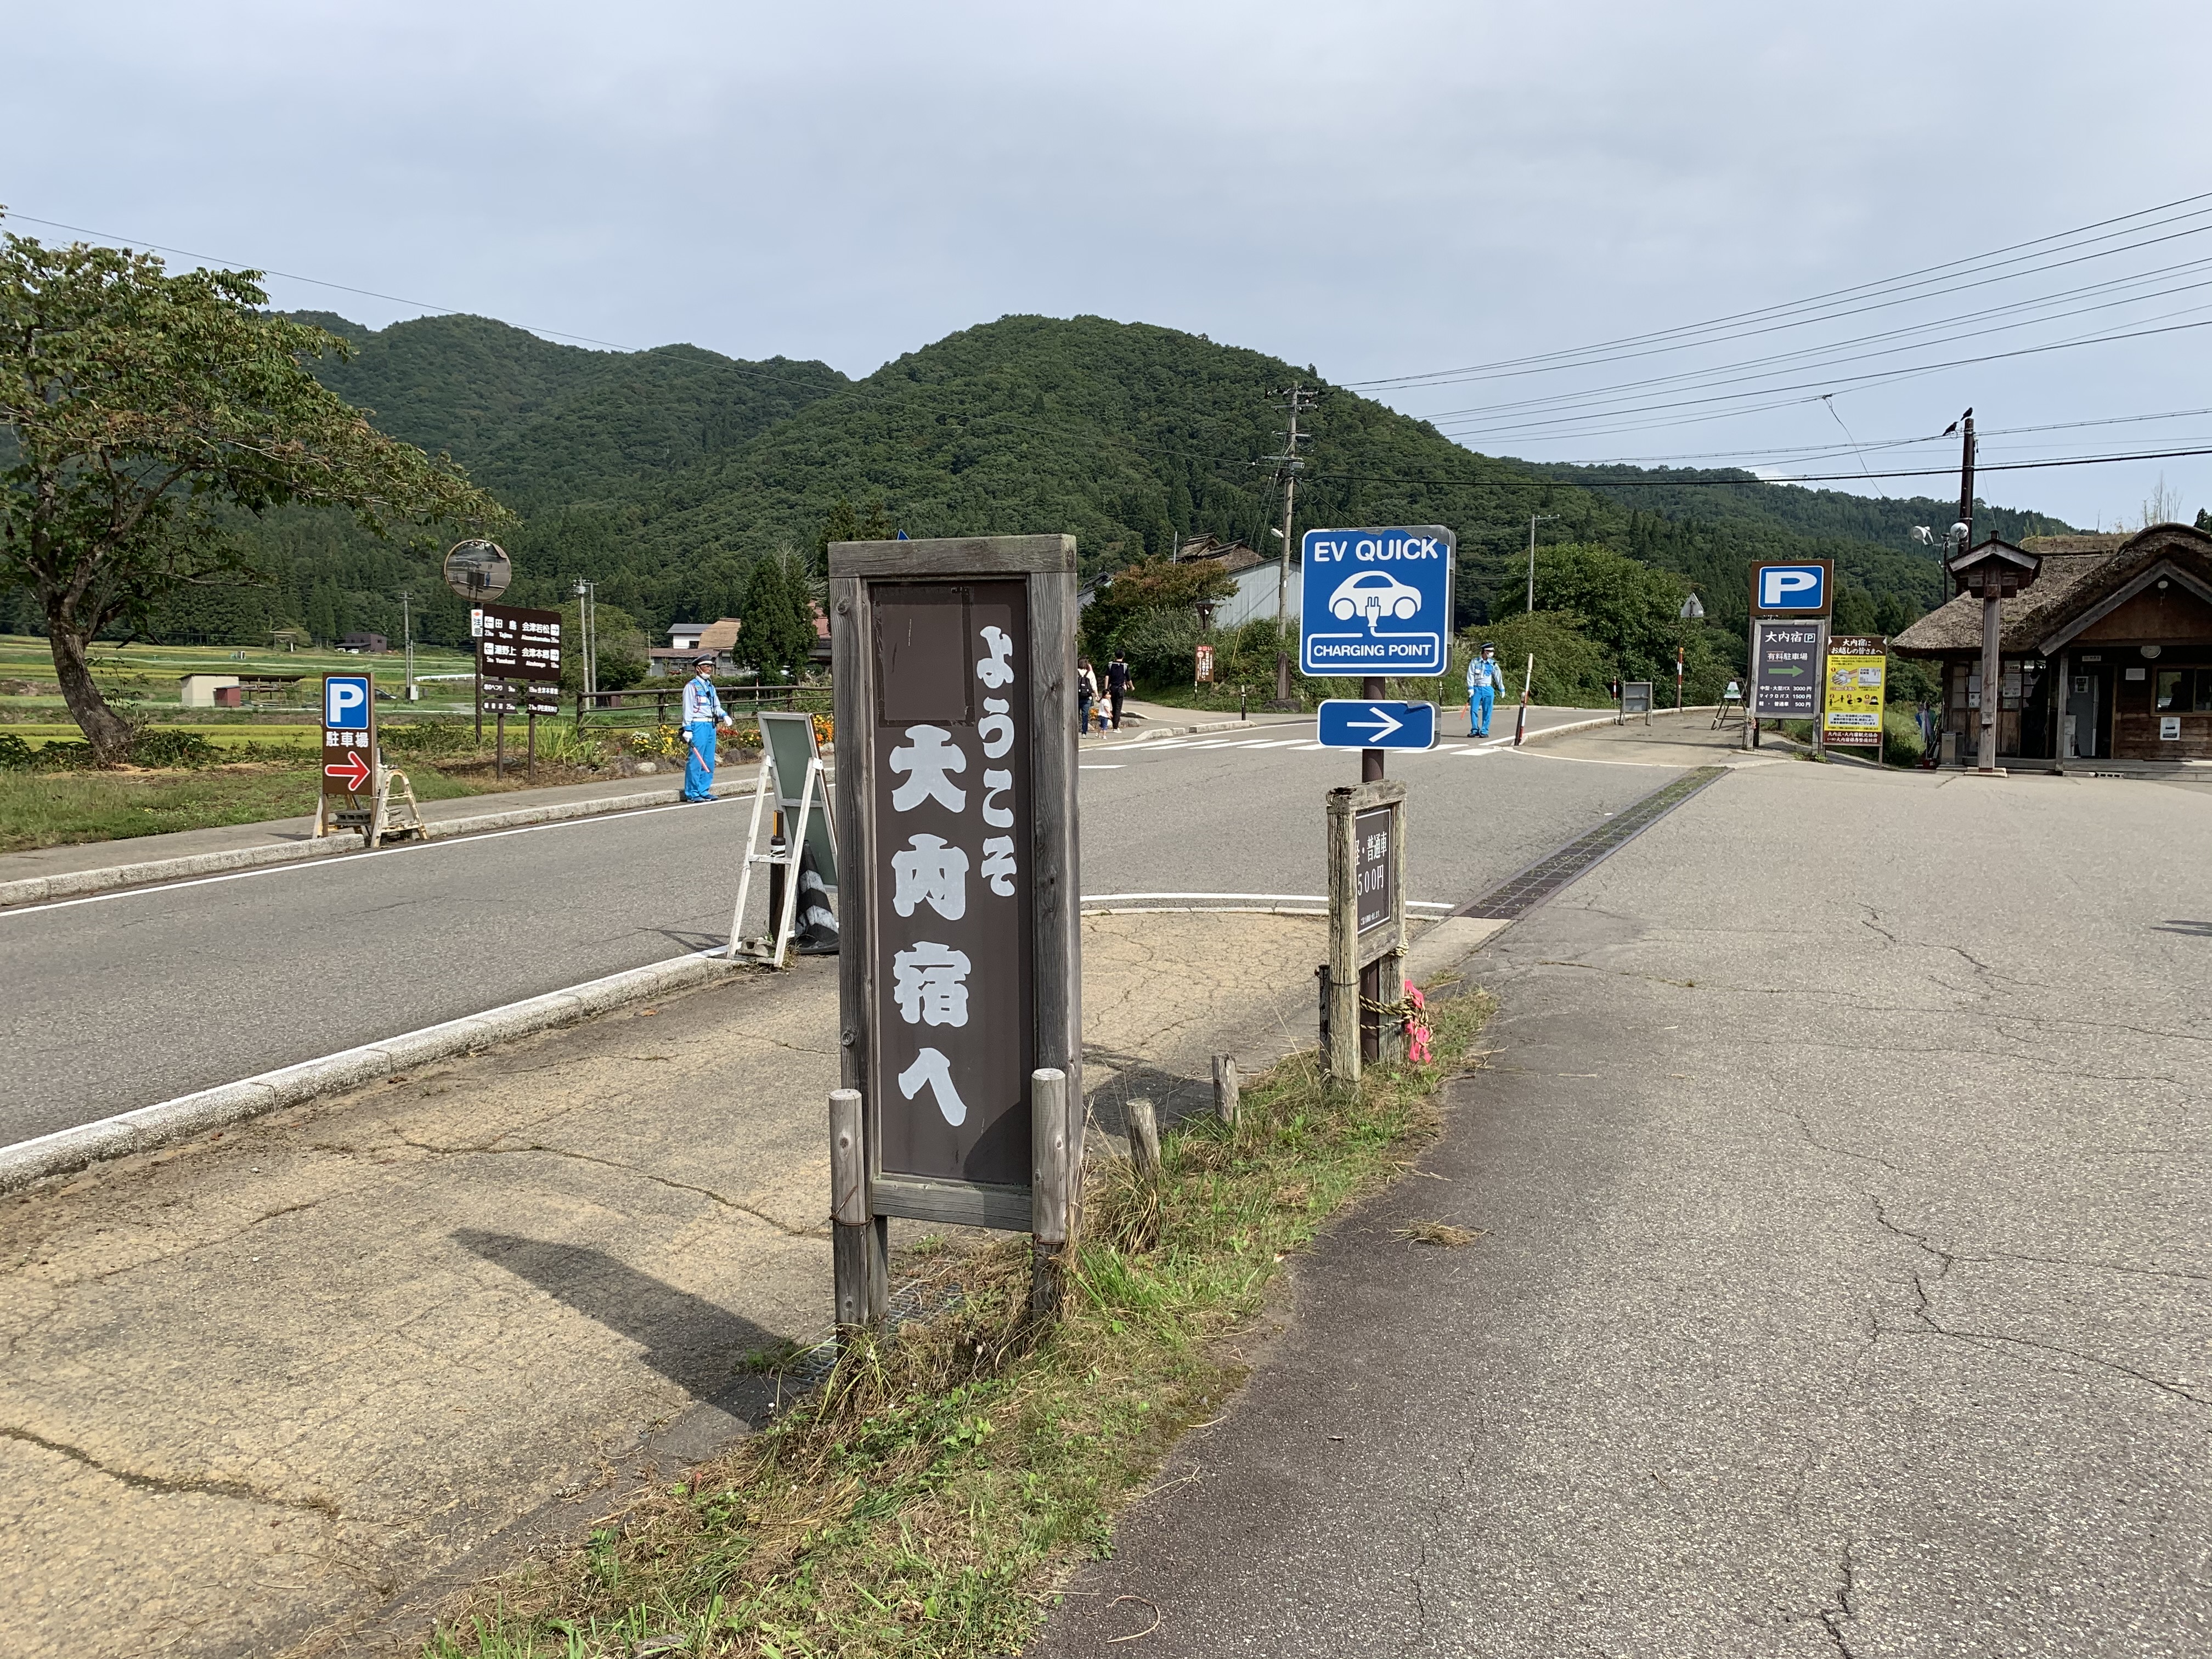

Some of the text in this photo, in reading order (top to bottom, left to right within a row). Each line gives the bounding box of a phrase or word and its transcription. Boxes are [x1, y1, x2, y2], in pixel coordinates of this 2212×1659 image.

[1314, 538, 1438, 562] EV QUICK
[1764, 571, 1817, 604] P
[473, 618, 482, 635] 注意
[522, 622, 550, 634] 会津若松
[1764, 631, 1803, 643] 大内宿
[494, 645, 517, 656] 湯野上
[522, 647, 550, 659] 会津本郷
[1313, 644, 1432, 657] CHARGING POINT
[1767, 652, 1808, 661] 有料駐車場
[1831, 646, 1883, 654] お越しの皆さまへ
[330, 684, 364, 723] P
[326, 731, 369, 748] 駐車場
[977, 626, 1017, 896] ようこそ
[1358, 864, 1384, 896] 500円
[890, 724, 971, 1127] 大内宿へ
